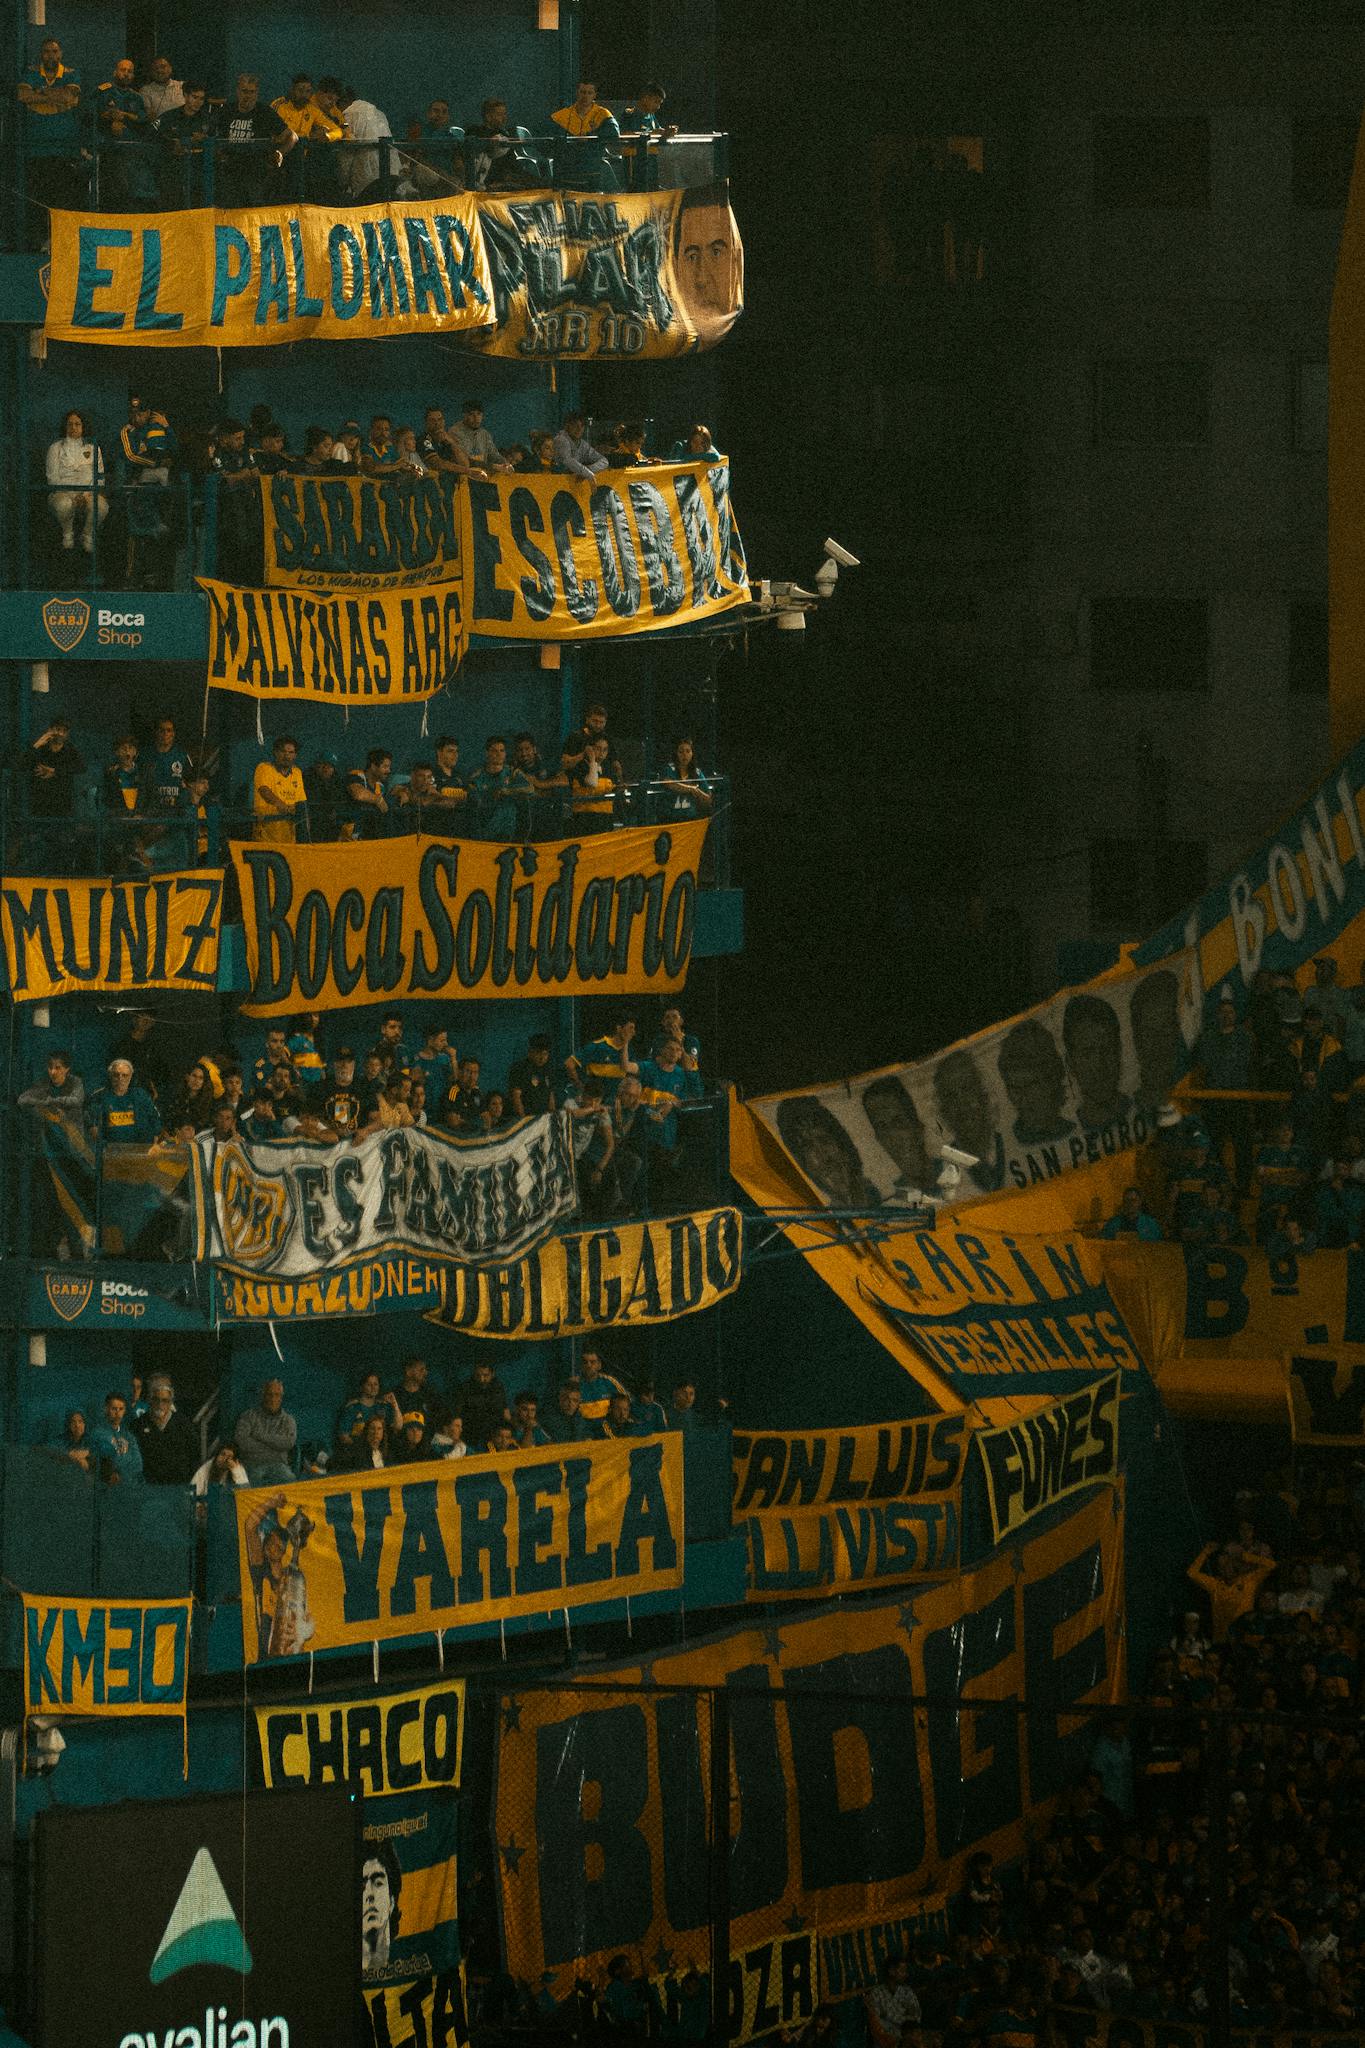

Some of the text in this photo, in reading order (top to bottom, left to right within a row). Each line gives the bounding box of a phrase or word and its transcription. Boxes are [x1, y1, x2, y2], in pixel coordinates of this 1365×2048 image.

[509, 199, 629, 240] FILIAL
[71, 214, 489, 331] EL PALOMAR
[48, 615, 84, 626] CABJ
[97, 609, 145, 627] Boca
[97, 627, 142, 648] Shop
[209, 589, 392, 695] MALVINAS
[2, 878, 221, 990] MUNIZ
[244, 831, 697, 1001] Boca Solidario
[1009, 1115, 1148, 1189] SAN PEDRO
[100, 1297, 146, 1319] Shop
[911, 1311, 1141, 1375] VERSAILLES
[826, 1415, 966, 1502] LUIS
[978, 1378, 1116, 1532] FUNES
[325, 1441, 680, 1624] VARELA
[268, 1692, 461, 1790] CHACO
[533, 1533, 1110, 1966] BUDGE
